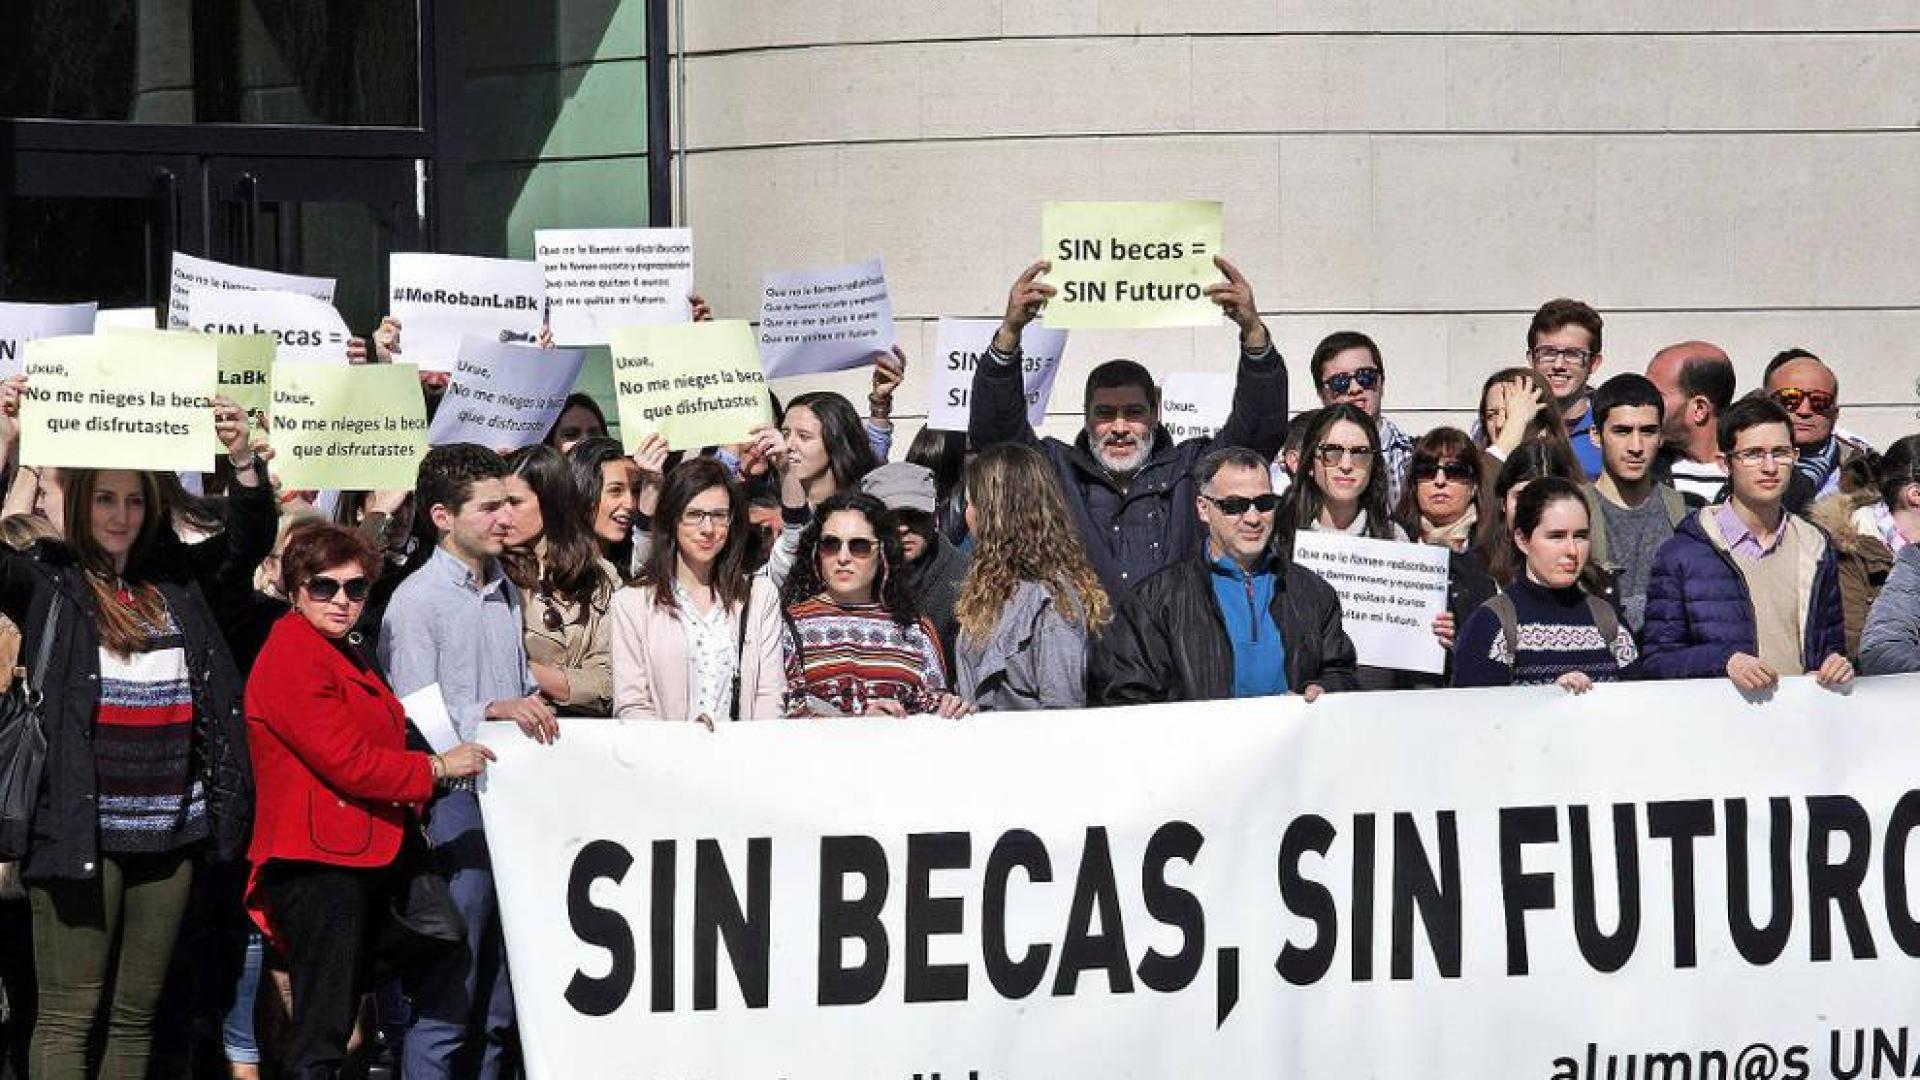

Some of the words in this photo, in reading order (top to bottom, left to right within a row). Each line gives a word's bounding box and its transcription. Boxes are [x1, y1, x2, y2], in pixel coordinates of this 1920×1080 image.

[1058, 238, 1101, 261] SIN
[1110, 238, 1184, 261] becas
[393, 287, 538, 311] #MeRobanLaBk
[1063, 280, 1106, 302] SIN
[1116, 280, 1201, 302] Futuro
[616, 356, 654, 369] Uxue,
[620, 381, 643, 395] No
[647, 379, 670, 392] me
[674, 373, 719, 390] nieges
[721, 369, 734, 383] la
[735, 368, 765, 384] beca
[27, 387, 51, 401] No
[56, 390, 84, 402] me
[89, 391, 145, 408] nieges
[151, 391, 165, 406] la
[171, 392, 212, 408] beca
[274, 391, 315, 405] Uxue,
[450, 382, 470, 397] No
[472, 389, 495, 402] me
[948, 388, 968, 407] SI
[458, 410, 485, 425] que
[643, 404, 673, 422] que
[676, 395, 759, 416] disfrutastes
[48, 418, 80, 433] que
[85, 416, 189, 436] disfrutastes
[274, 416, 297, 430] No
[302, 419, 326, 431] me
[331, 418, 380, 434] nieges
[384, 417, 397, 430] la
[401, 418, 426, 430] beca
[292, 444, 322, 459] que
[327, 442, 415, 457] disfrutastes
[563, 837, 772, 1016] SIN
[817, 820, 1240, 1030] BECAS,
[1274, 809, 1462, 986] SIN
[1550, 1043, 1810, 1080] alumn@s
[1830, 1027, 1920, 1080] UN
